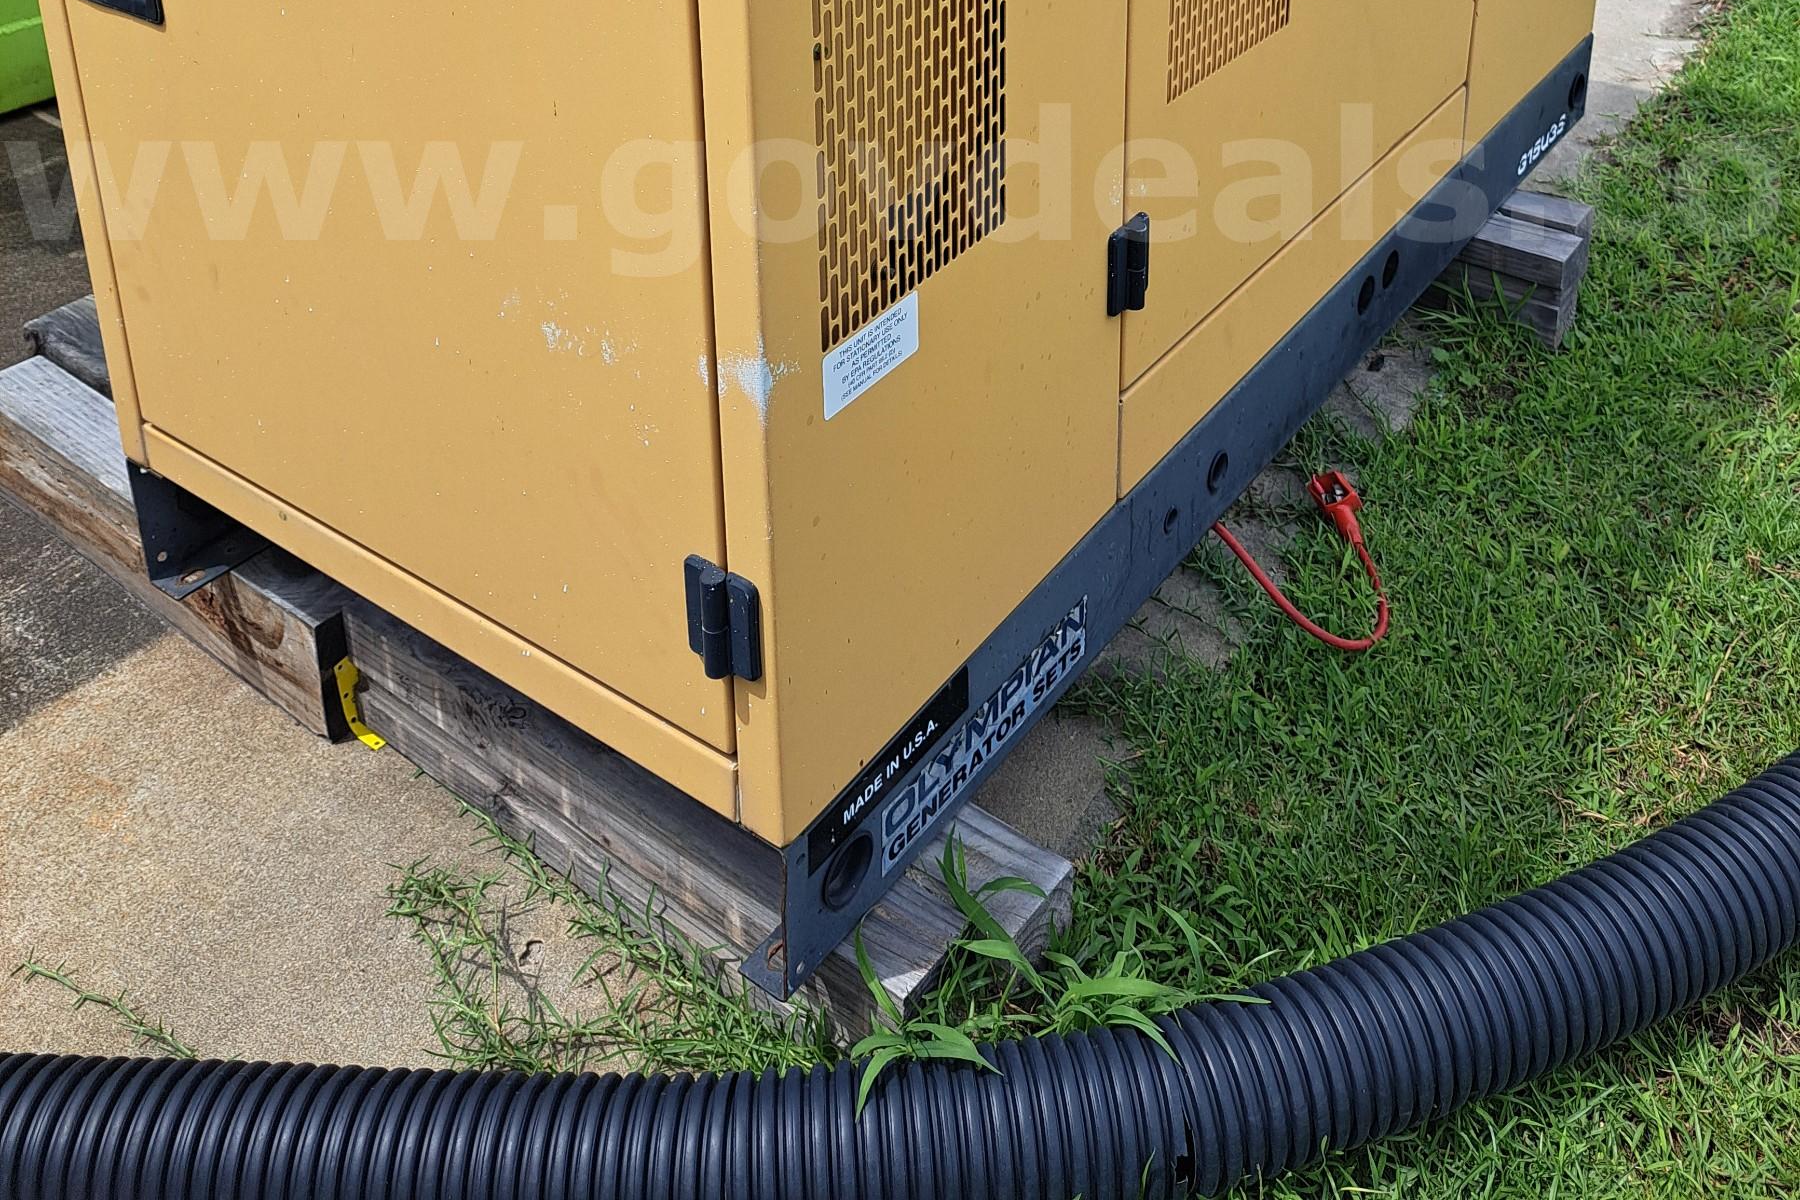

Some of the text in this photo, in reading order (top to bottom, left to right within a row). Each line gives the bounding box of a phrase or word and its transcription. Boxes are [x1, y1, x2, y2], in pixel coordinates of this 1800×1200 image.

[833, 358, 846, 373] FOR
[846, 332, 881, 363] STATIONARY
[881, 322, 893, 336] USE
[893, 311, 908, 327] ONLY
[839, 344, 853, 359] THIS
[853, 333, 867, 348] UNIT
[875, 307, 902, 331] INTENDED
[841, 372, 850, 384] BY
[850, 365, 862, 377] EPA
[862, 334, 902, 369] REGULATIONS
[851, 357, 860, 368] AS
[860, 333, 892, 363] PERMITTED
[884, 603, 1085, 838] OLYMPIAN
[888, 636, 1084, 862] GENERATOR SETS
[843, 720, 939, 825] MADE IN U.S.A.
